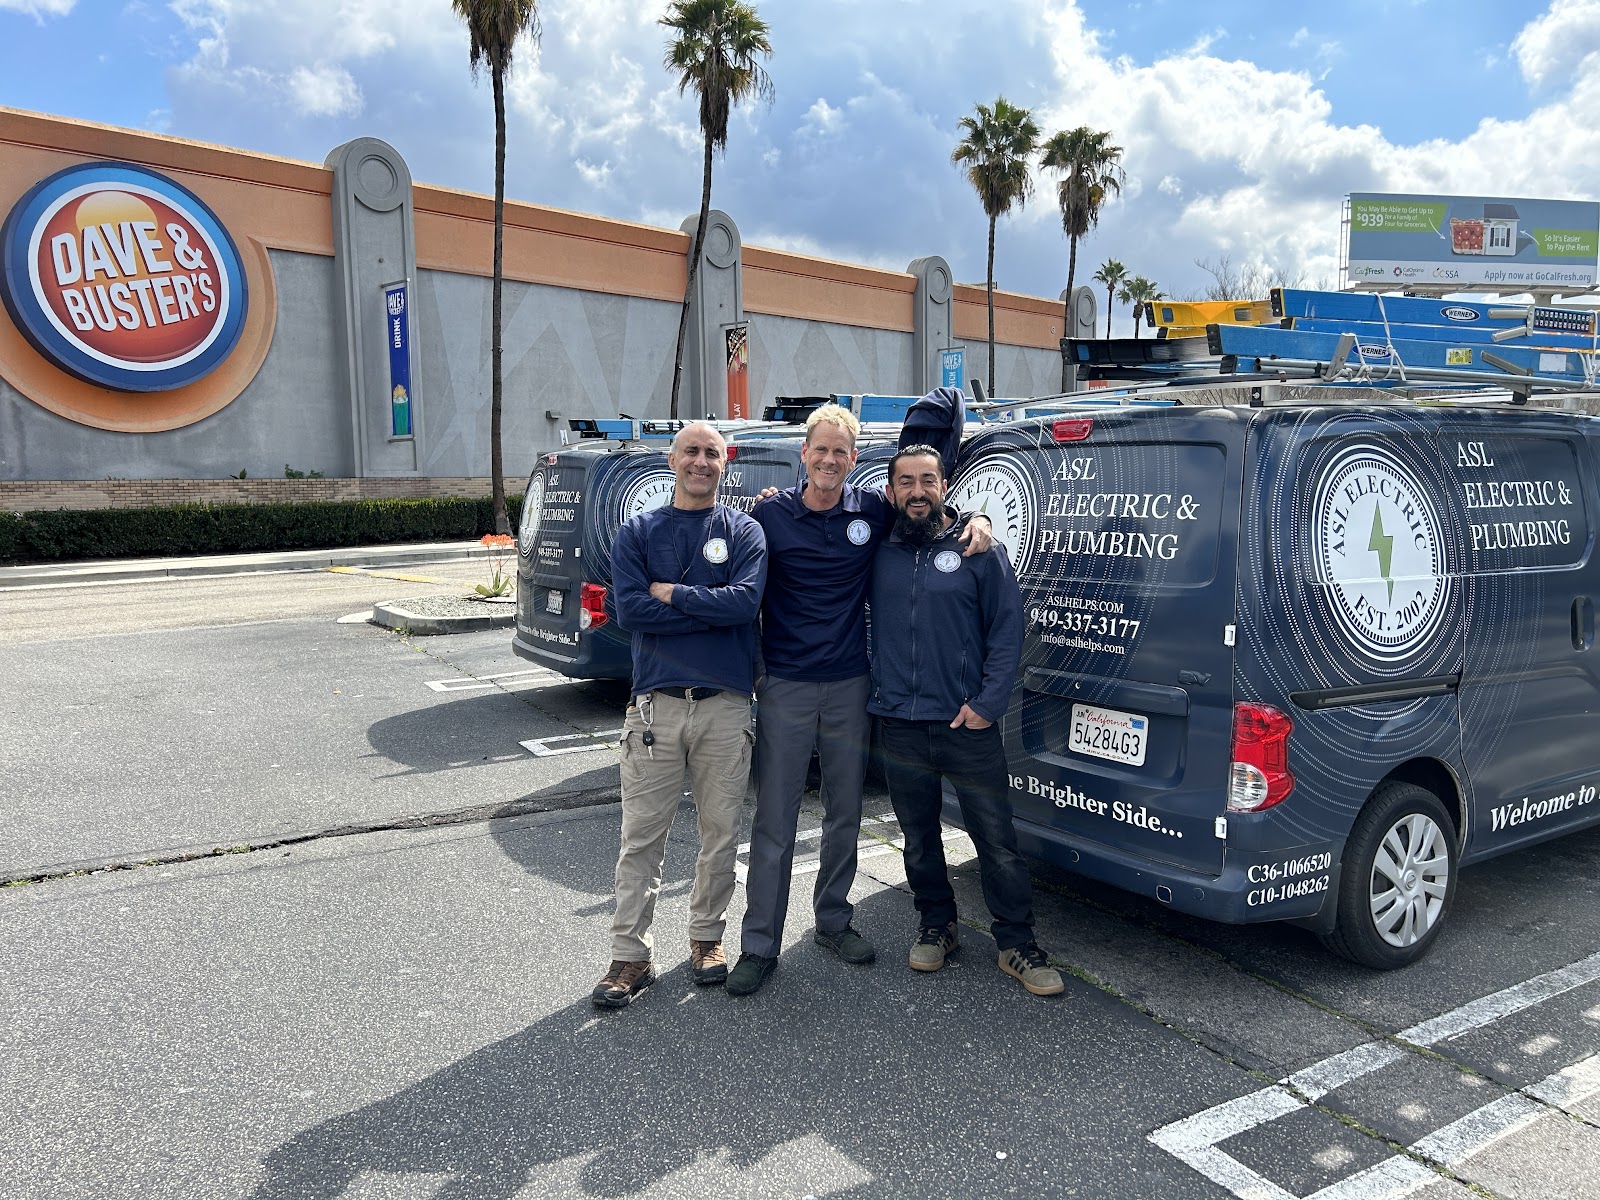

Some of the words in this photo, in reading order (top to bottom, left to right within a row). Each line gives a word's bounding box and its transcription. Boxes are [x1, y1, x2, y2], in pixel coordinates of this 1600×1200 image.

[1357, 213, 1384, 227] $939
[1419, 207, 1426, 215] Up
[1544, 234, 1551, 242] So
[1553, 234, 1562, 242] It's
[1563, 235, 1581, 243] Easier
[1555, 243, 1564, 252] Pay
[51, 221, 173, 286] DAVE
[165, 223, 208, 270] &
[1484, 270, 1506, 281] Apply
[1508, 272, 1524, 280] now
[1525, 272, 1533, 280] at
[1535, 272, 1591, 283] GoCalFresh.org
[61, 272, 216, 332] BUSTER'S
[1448, 310, 1473, 318] WERNER
[393, 317, 402, 349] DRINK
[1361, 347, 1387, 355] WERNER
[948, 371, 956, 388] ATCH
[733, 403, 741, 420] LAY
[1457, 441, 1494, 467] ASL
[723, 471, 743, 488] ASL
[1051, 457, 1097, 481] ASL
[544, 491, 574, 504] ELECTRIC
[574, 491, 581, 504] &
[634, 498, 647, 513] SL
[1463, 481, 1556, 508] ELECTRIC
[1558, 480, 1573, 505] &
[542, 508, 575, 522] PLUMBING
[967, 476, 1019, 539] ELECTRIC
[1045, 493, 1171, 520] ELECTRIC
[1176, 494, 1200, 520] &
[1331, 506, 1350, 558] ASL
[1343, 474, 1428, 551] ELECTRIC
[1039, 530, 1179, 560] PLUMBING
[1469, 519, 1571, 551] PLUMBING
[1047, 595, 1125, 614] ASLHELPS.COM
[1353, 593, 1391, 632] EST.
[1396, 590, 1428, 630] 2002
[1030, 607, 1140, 639] 949-337-3177
[1041, 632, 1125, 655] info@aslhelps.com
[1086, 710, 1133, 729] California
[1075, 722, 1140, 757] 54284G3
[1086, 748, 1124, 760] dmv.ca.gov
[1027, 775, 1108, 816] Brighter
[1112, 800, 1183, 839] Side...
[1490, 791, 1575, 832] Welcome
[1577, 784, 1596, 806] to
[1247, 851, 1331, 883] C36-1066520
[1247, 875, 1330, 906] C10-1048262
